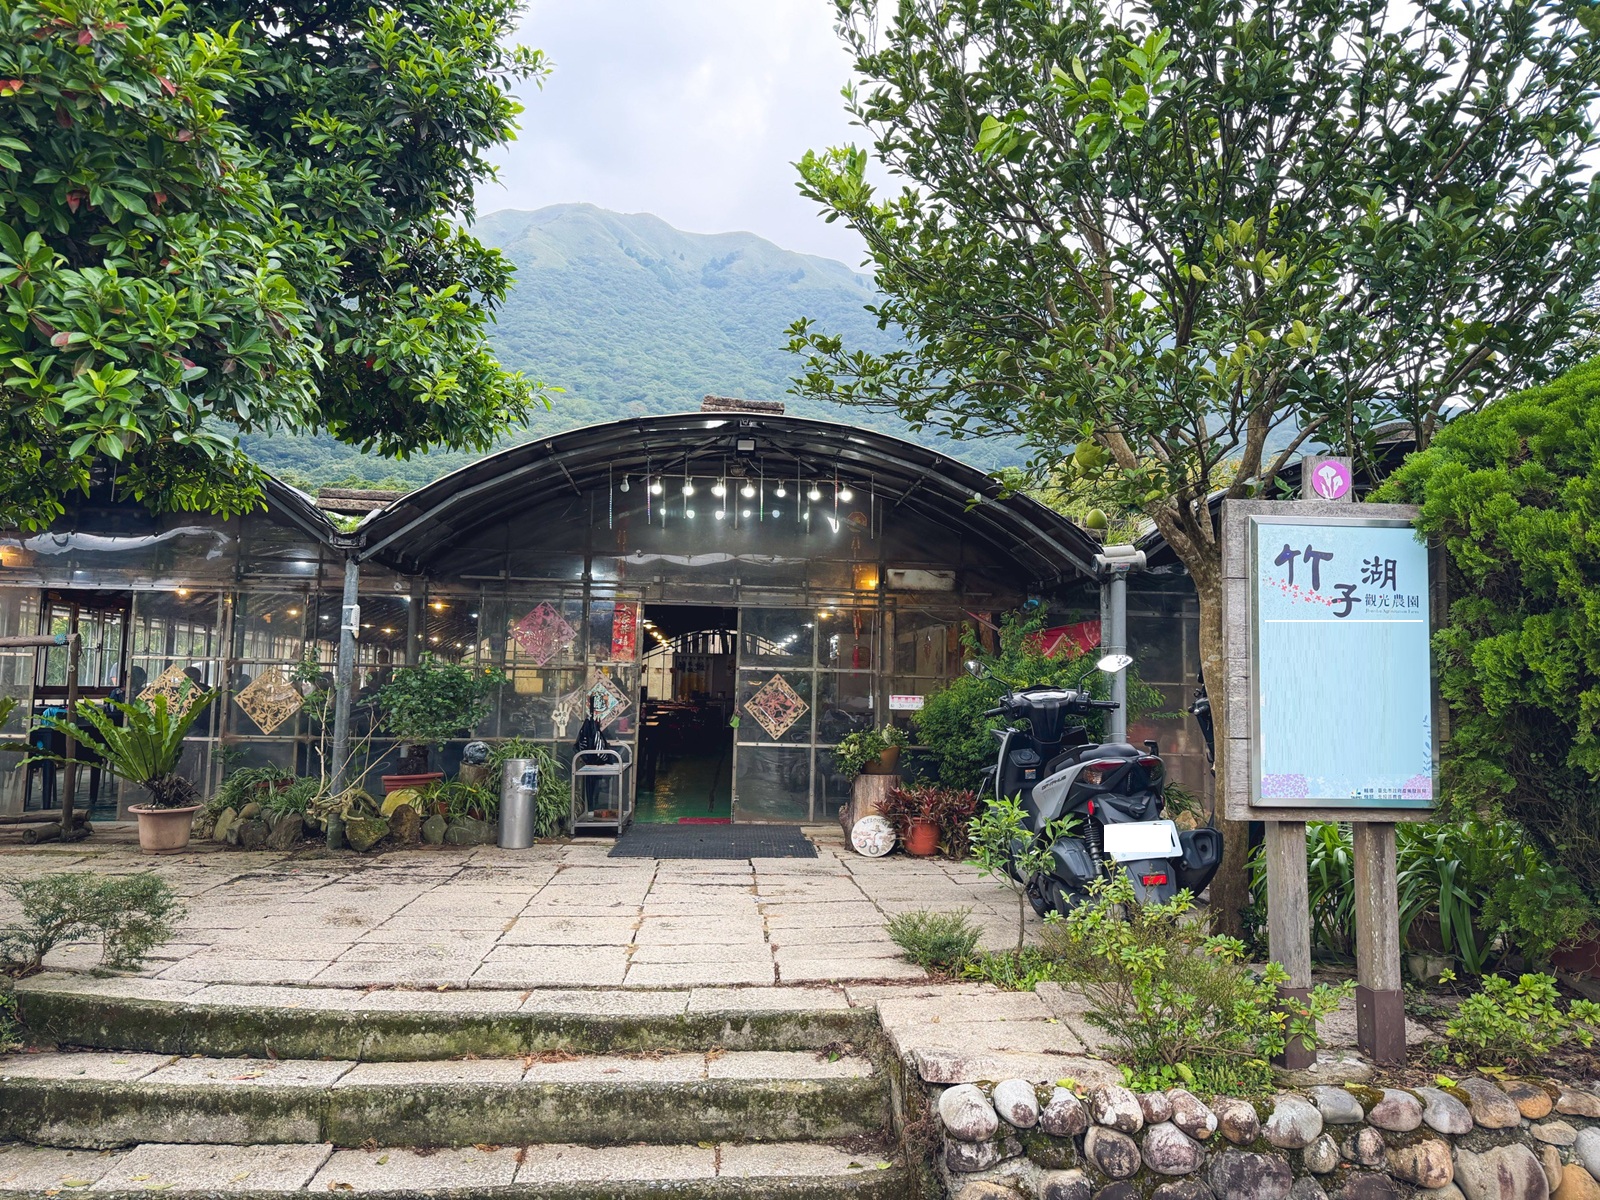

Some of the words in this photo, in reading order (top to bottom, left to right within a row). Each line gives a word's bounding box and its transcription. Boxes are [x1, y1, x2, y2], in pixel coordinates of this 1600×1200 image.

[1274, 543, 1397, 618] 竹子湖
[1365, 593, 1419, 609] 觀光農園
